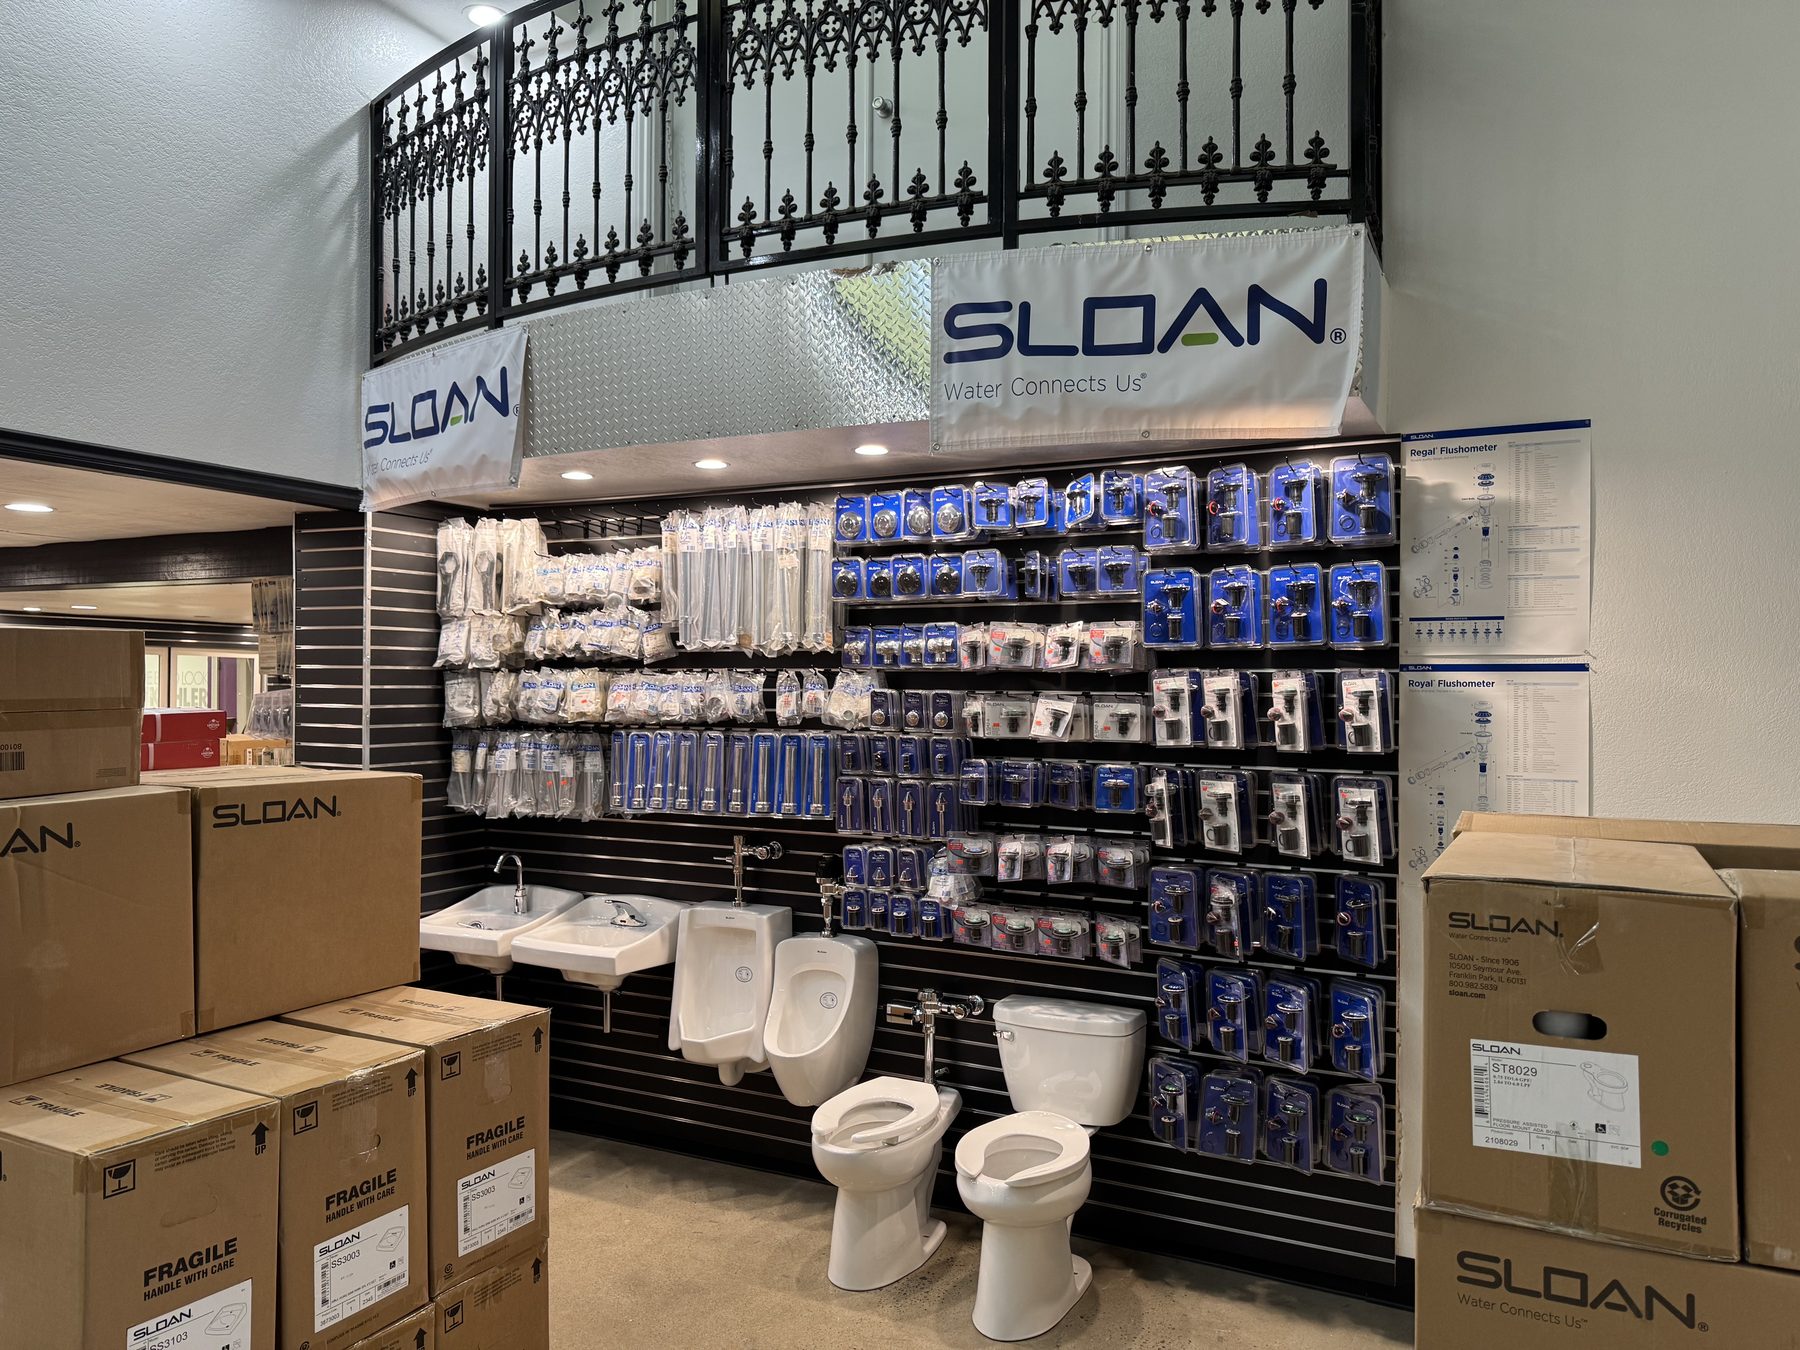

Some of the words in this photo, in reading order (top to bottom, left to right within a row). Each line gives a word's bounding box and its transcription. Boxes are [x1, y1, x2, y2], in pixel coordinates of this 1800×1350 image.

[944, 382, 1002, 400] Water
[1012, 375, 1106, 397] Connects
[1410, 448, 1436, 457] Regal
[1440, 444, 1497, 454] Flushometer
[380, 454, 417, 472] Connects
[1408, 680, 1433, 688] Royal
[1438, 680, 1495, 688] Flushometer
[1469, 934, 1498, 942] Connects
[1449, 953, 1474, 962] SLOAN
[1480, 956, 1500, 965] Since
[1502, 958, 1520, 966] 1906
[1449, 962, 1471, 970] 10500
[1473, 964, 1504, 974] Seymour
[1449, 971, 1477, 980] Franklin
[1449, 980, 1498, 991] 800.982.5839
[1449, 990, 1486, 999] sloan.com
[360, 1012, 404, 1022] FRAGILE
[1472, 1043, 1520, 1055] SLOAN
[212, 1054, 261, 1066] FRAGILE
[1492, 1063, 1538, 1076] ST8029
[408, 1087, 416, 1097] UP
[33, 1102, 85, 1117] FRAGILE
[466, 1116, 525, 1149] FRAGILE
[466, 1145, 490, 1160] HANDLE
[492, 1138, 507, 1151] WITH
[508, 1132, 523, 1143] CARE
[1485, 1136, 1519, 1147] 2108029
[255, 1145, 267, 1156] UP
[462, 1170, 495, 1190] SLOAN
[326, 1168, 397, 1211] FRAGILE
[472, 1185, 496, 1201] SS3003
[326, 1203, 355, 1223] HANDLE
[357, 1194, 375, 1211] WITH
[377, 1186, 395, 1200] CARE
[1654, 1207, 1707, 1226] Corrugated
[1658, 1217, 1702, 1234] Recycles
[319, 1232, 360, 1257] SLOAN
[144, 1237, 237, 1287] FRAGILE
[331, 1249, 360, 1269] SS3003
[144, 1279, 181, 1301] HANDLE
[185, 1268, 208, 1285] WITH
[211, 1258, 234, 1275] CARE
[1456, 1291, 1495, 1312] Water
[1500, 1301, 1561, 1325] Connects
[133, 1309, 192, 1341] SLOAN
[150, 1331, 188, 1350] SS3103
